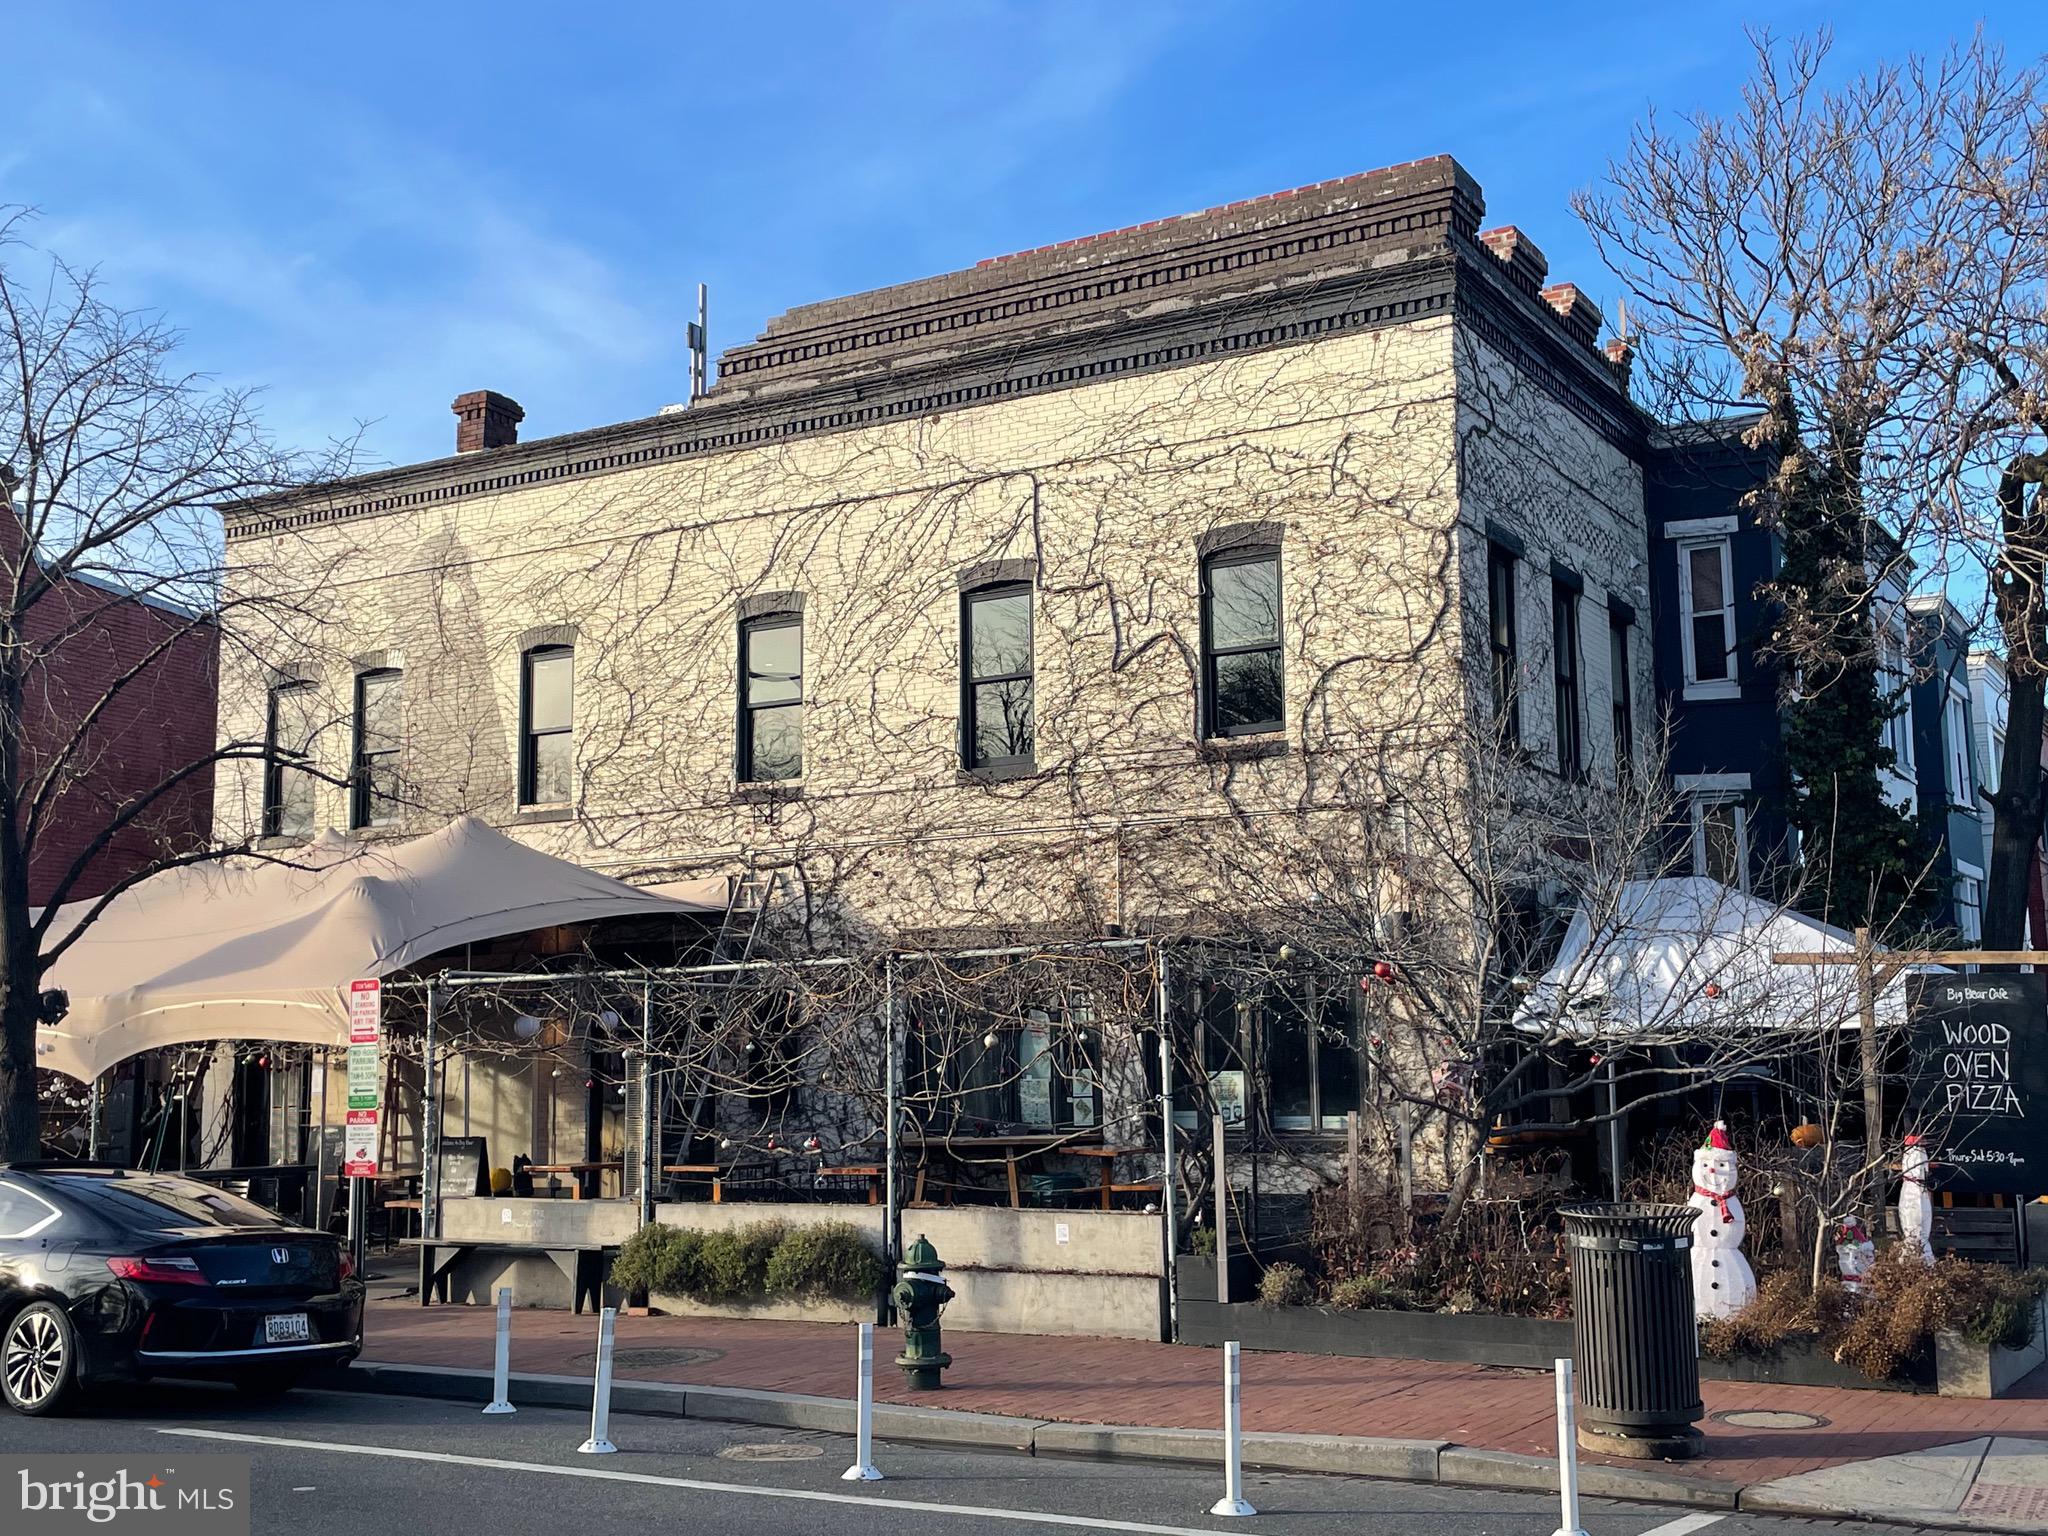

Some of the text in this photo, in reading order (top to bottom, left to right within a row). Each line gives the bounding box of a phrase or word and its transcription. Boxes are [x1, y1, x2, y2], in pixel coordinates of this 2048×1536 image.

[360, 992, 370, 1000] NO
[1946, 988, 2009, 1004] Big Bear Cafe
[1941, 1020, 2010, 1045] WOOD
[1944, 1051, 2009, 1080] OVEN
[1946, 1084, 2024, 1118] PIZZA
